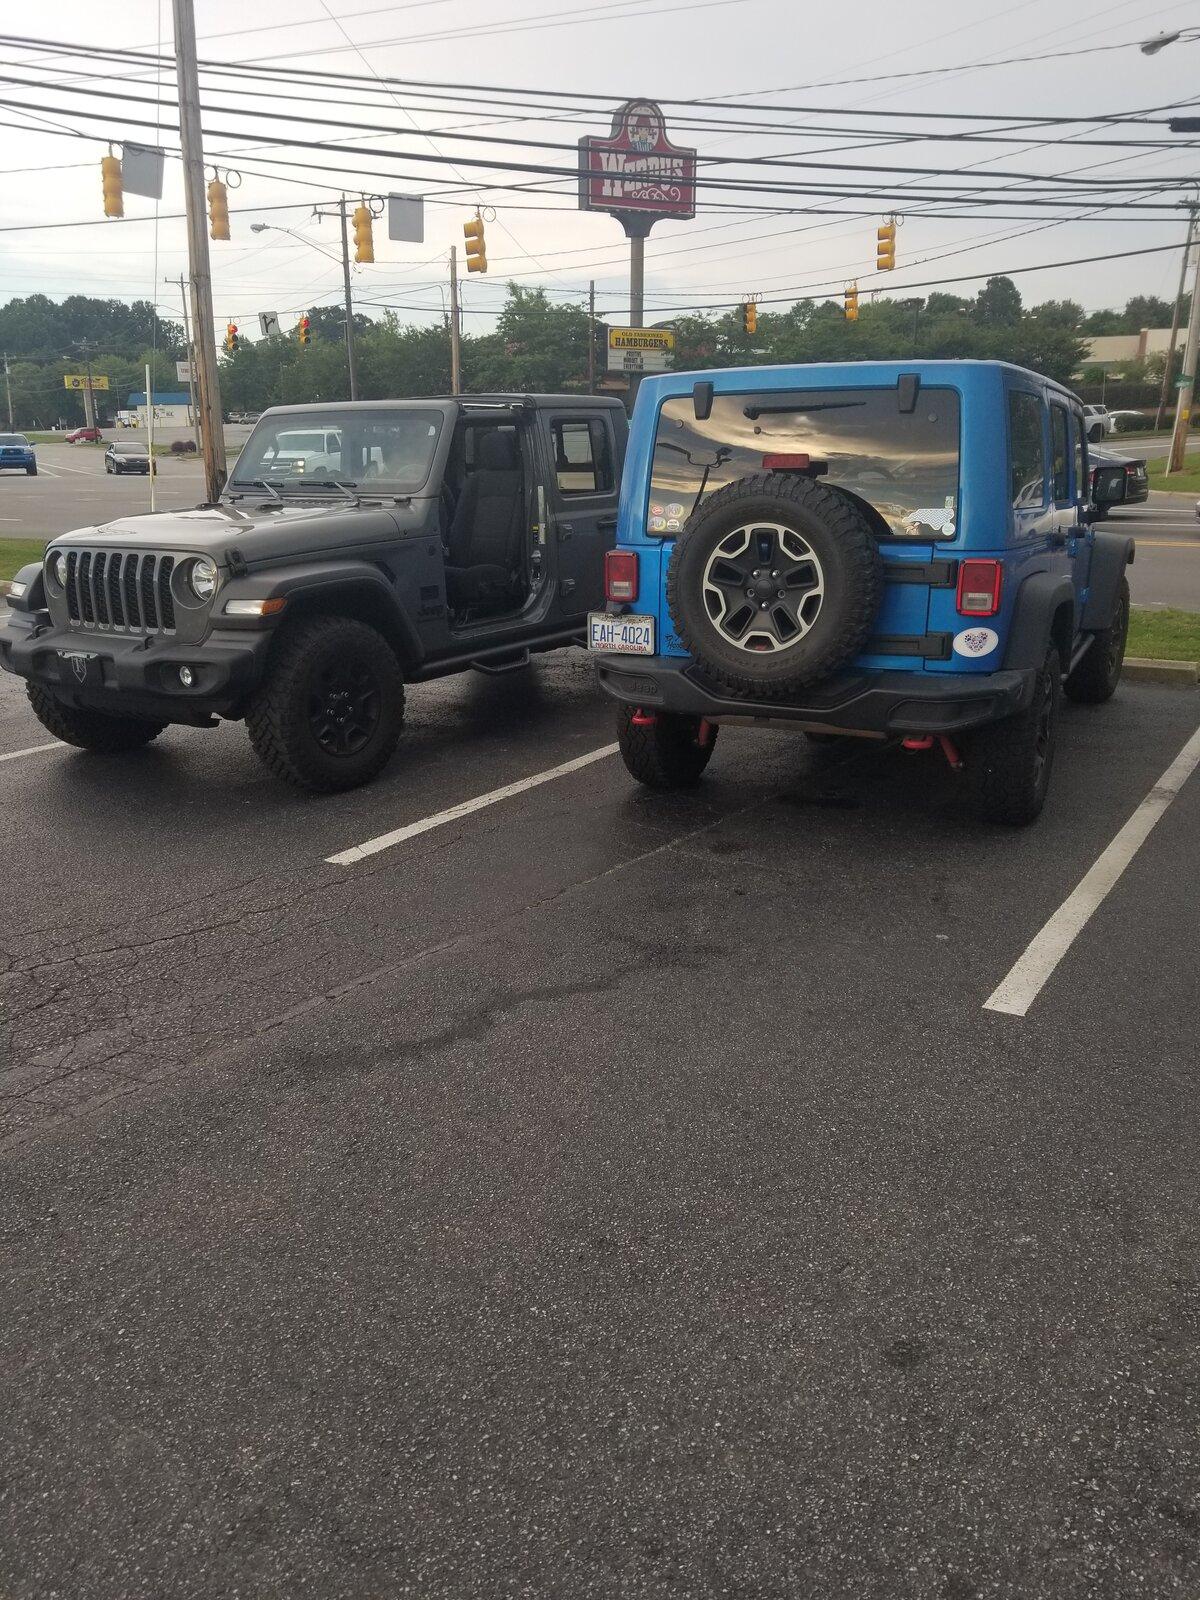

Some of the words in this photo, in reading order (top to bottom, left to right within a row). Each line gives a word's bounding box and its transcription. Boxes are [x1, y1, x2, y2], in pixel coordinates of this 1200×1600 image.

[600, 153, 683, 197] Wendys
[615, 337, 669, 348] HAMBURGERS
[592, 623, 650, 645] EAH-4024
[595, 642, 617, 650] NORTH
[617, 643, 647, 653] CAROLINA
